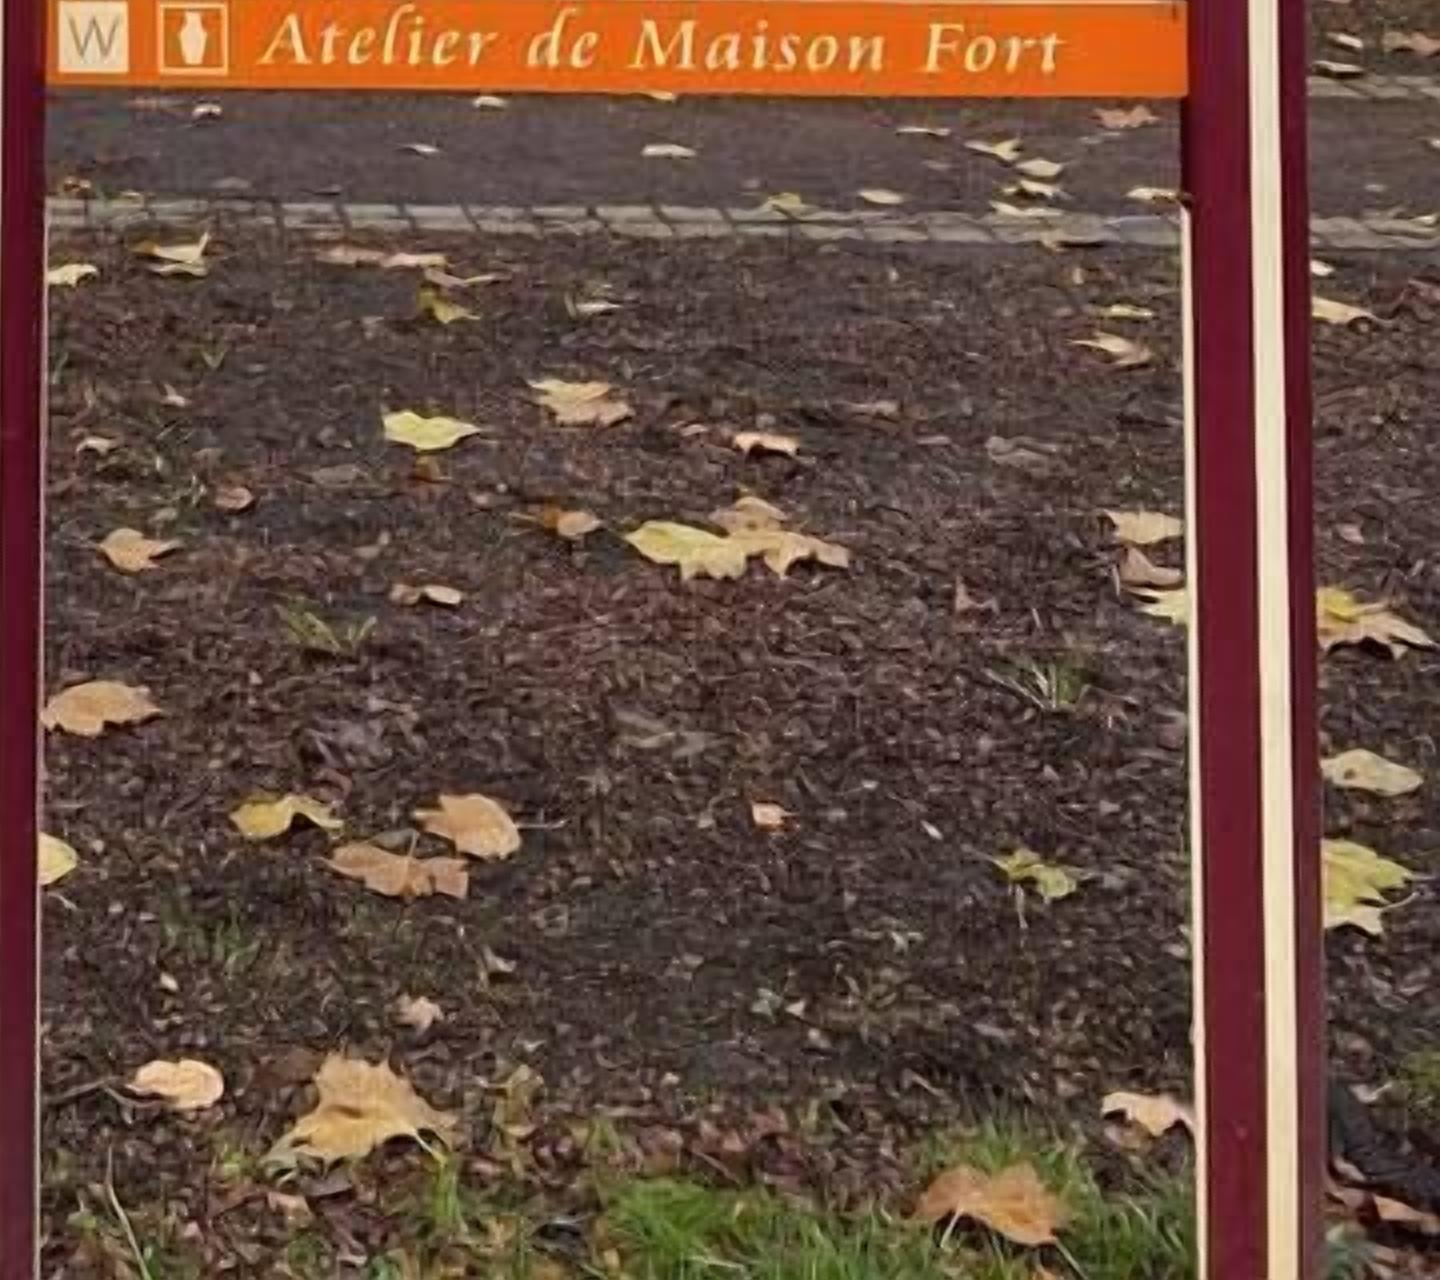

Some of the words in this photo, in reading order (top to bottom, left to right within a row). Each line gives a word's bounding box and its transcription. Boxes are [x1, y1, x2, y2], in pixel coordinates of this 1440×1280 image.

[67, 13, 123, 60] W
[259, 4, 498, 67] Atelier
[527, 8, 600, 70] de
[629, 19, 884, 73] Maison
[921, 22, 1065, 74] Fort
